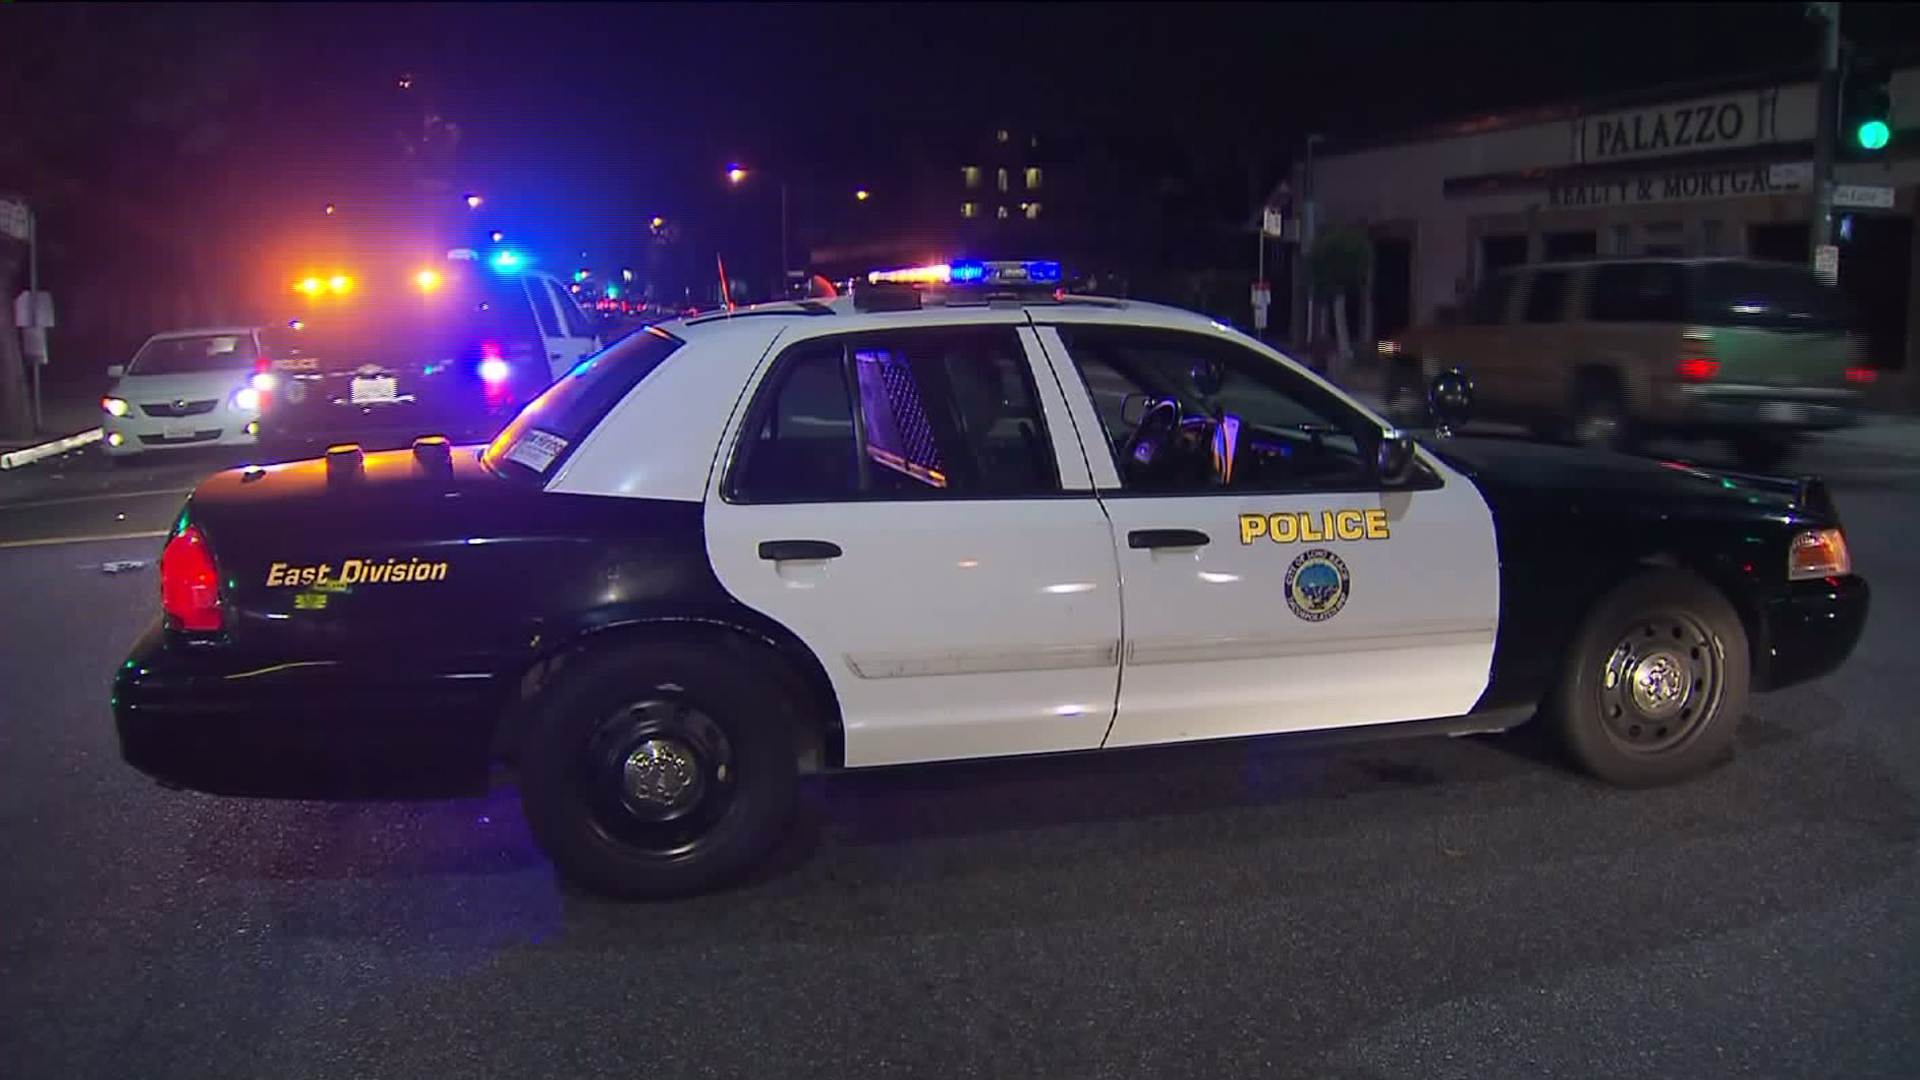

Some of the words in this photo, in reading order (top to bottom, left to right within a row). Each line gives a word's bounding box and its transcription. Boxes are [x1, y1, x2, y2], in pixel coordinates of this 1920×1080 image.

[1597, 103, 1743, 156] PALAZZO
[1549, 177, 1627, 205] REALTY
[1636, 176, 1653, 201] &
[1663, 165, 1801, 197] MORTGA
[1239, 509, 1391, 545] POLICE
[265, 561, 331, 588] East
[339, 556, 449, 585] Division
